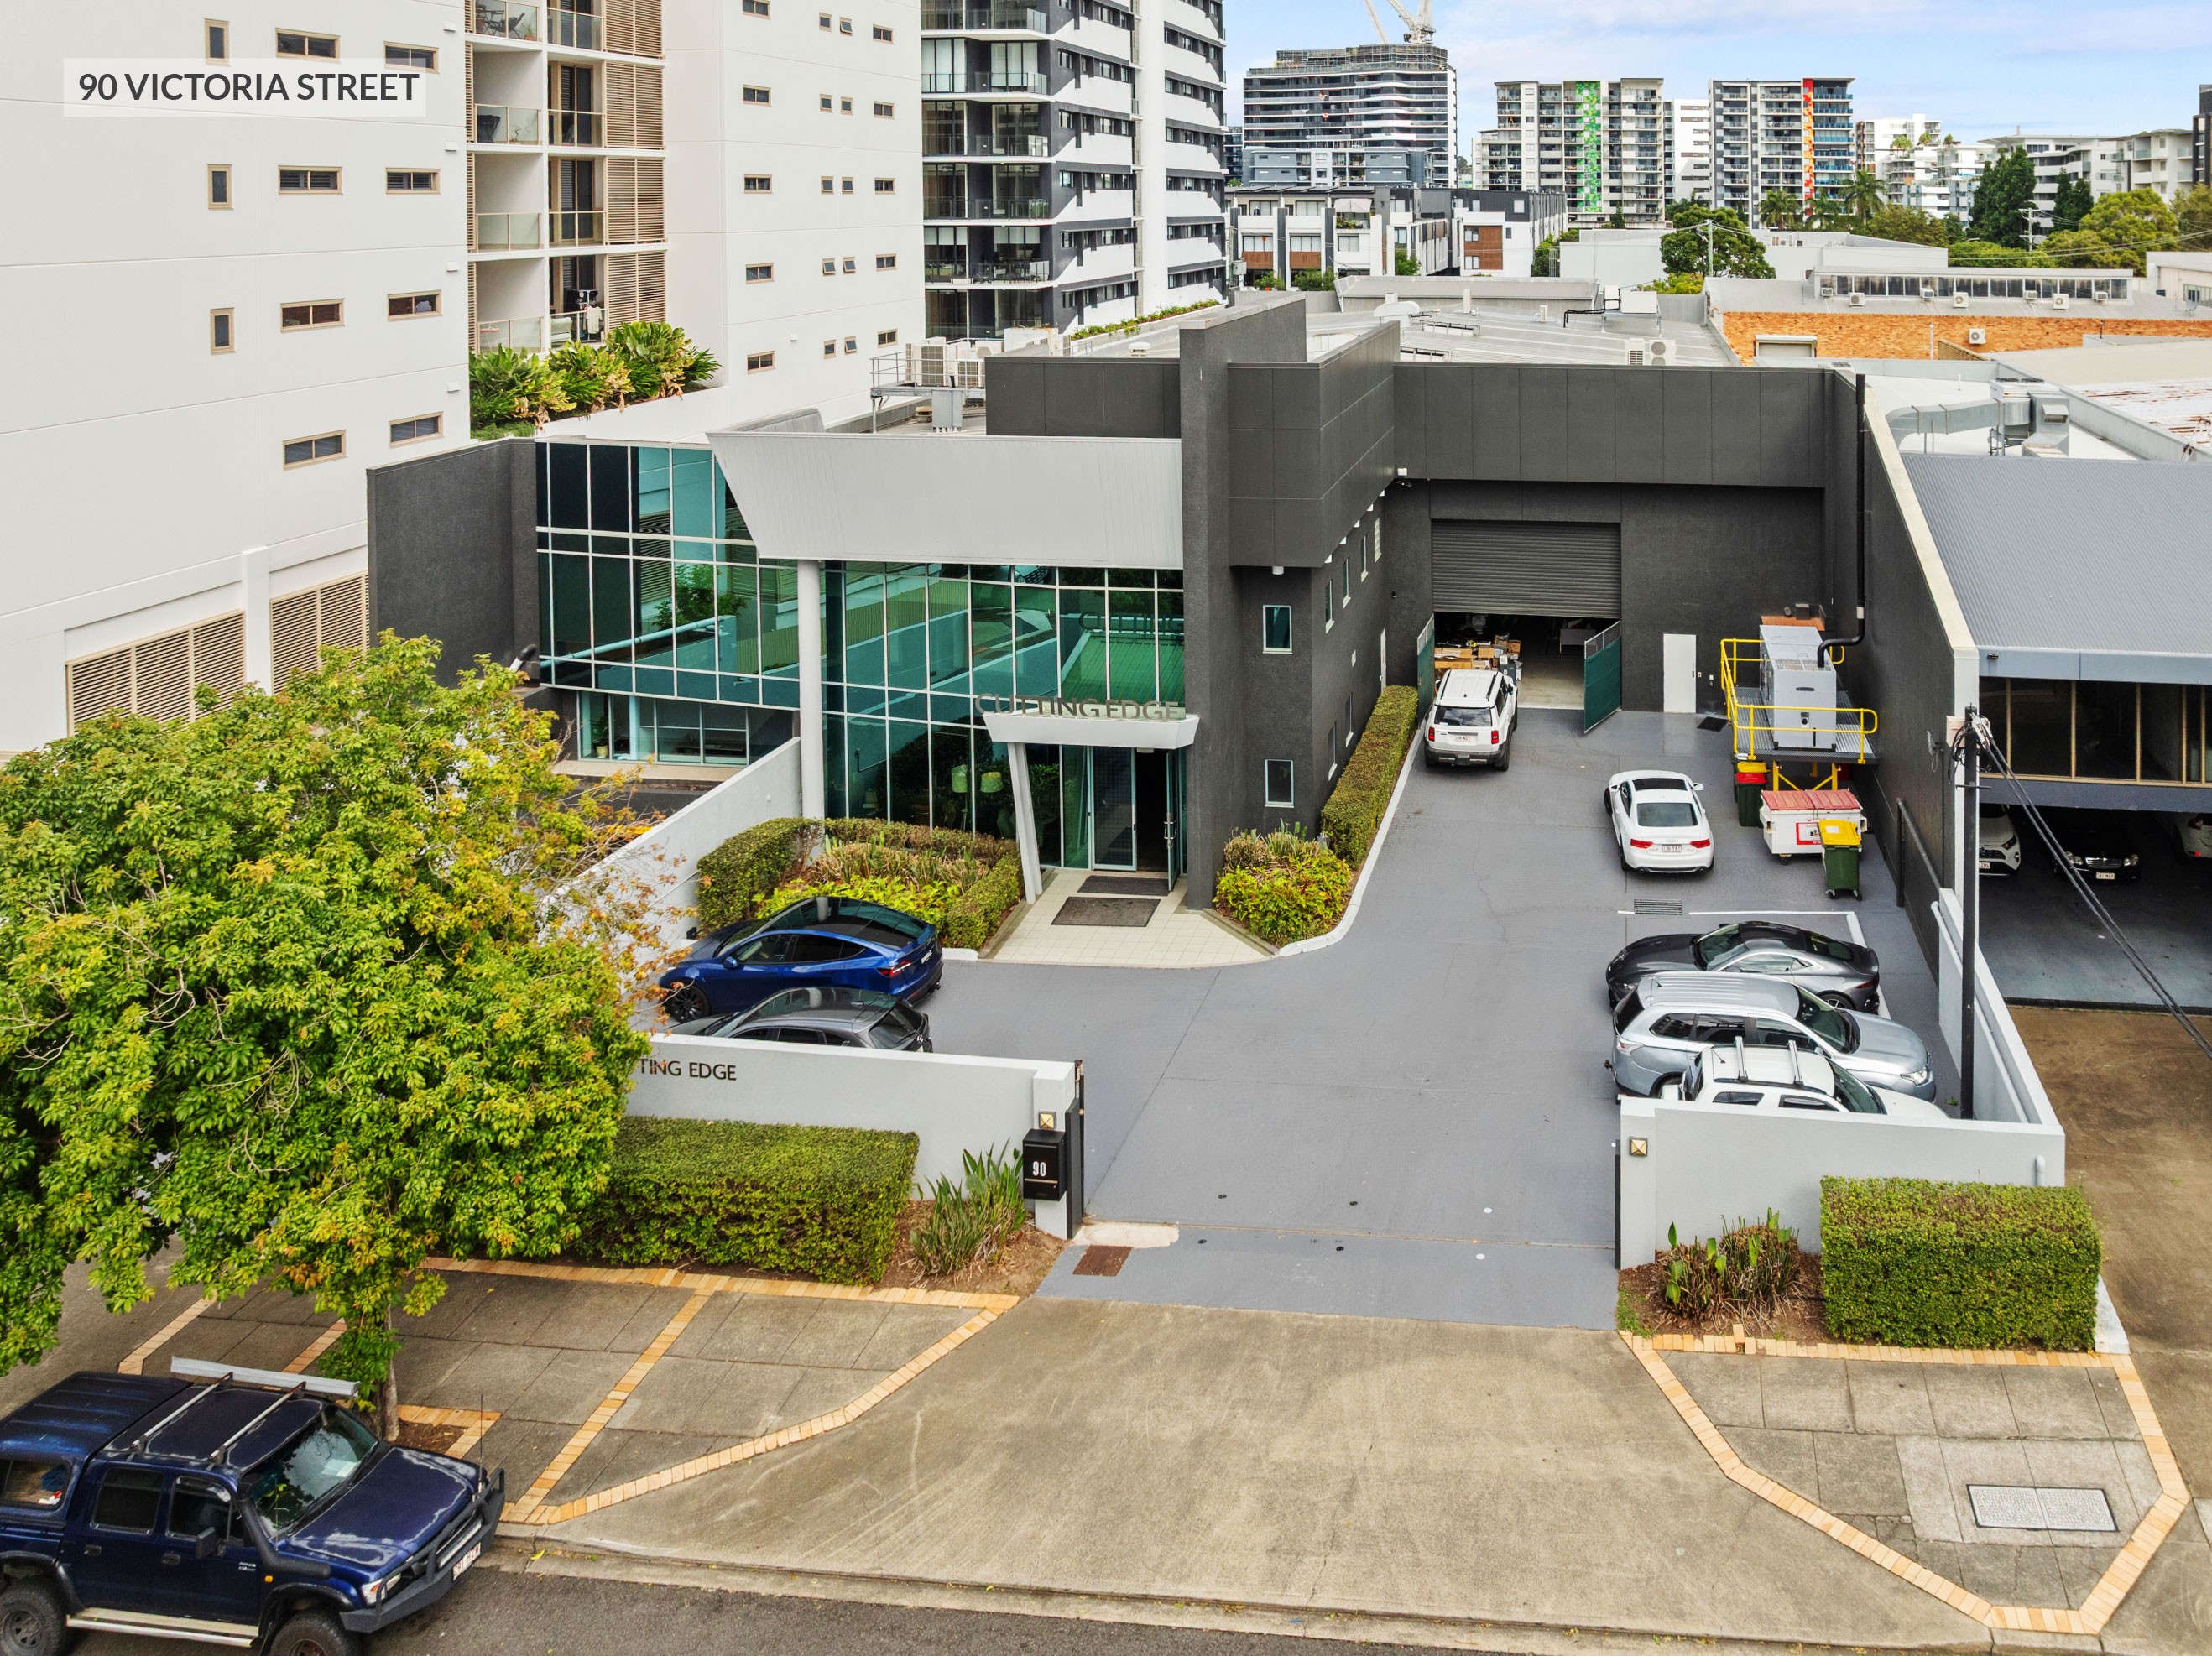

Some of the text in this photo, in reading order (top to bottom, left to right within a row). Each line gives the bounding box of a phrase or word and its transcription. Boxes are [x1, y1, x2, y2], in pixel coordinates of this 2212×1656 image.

[975, 693, 1178, 721] CUTTING EDGE
[689, 1062, 737, 1081] EDGE
[1033, 1161, 1046, 1177] 90
